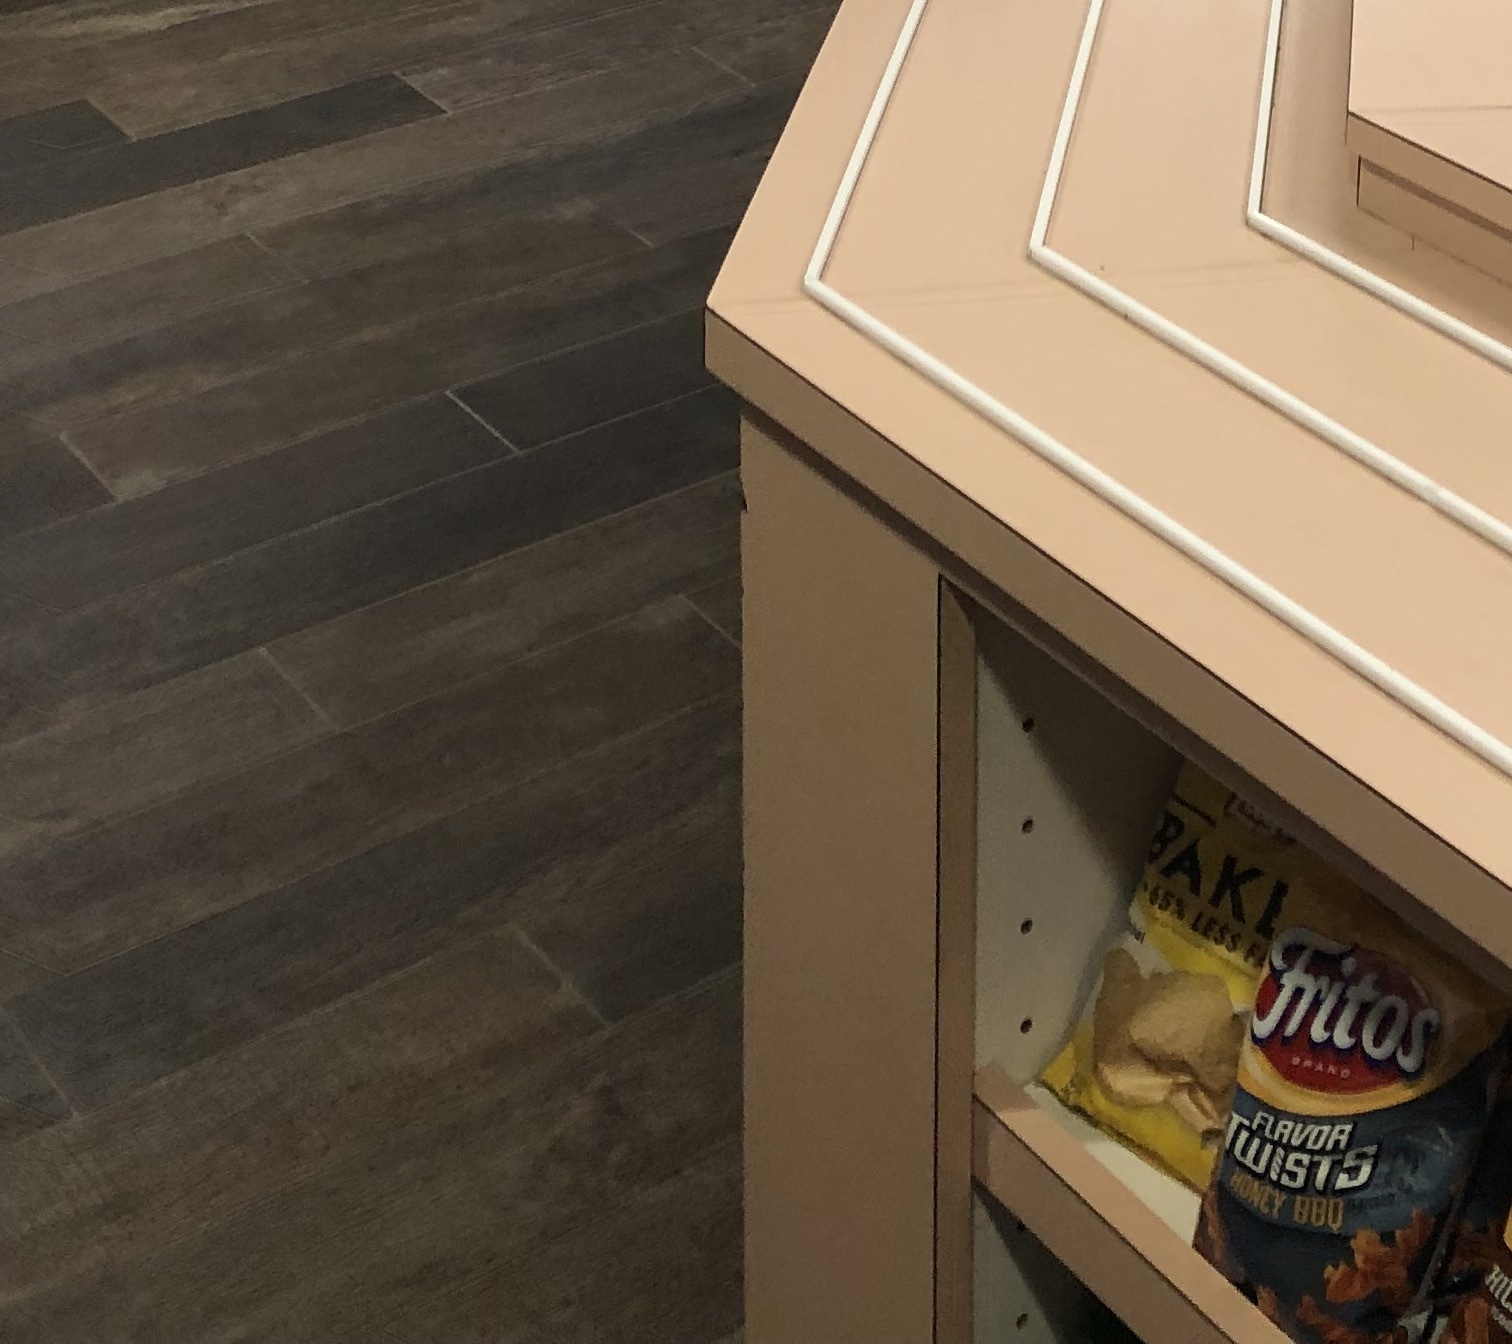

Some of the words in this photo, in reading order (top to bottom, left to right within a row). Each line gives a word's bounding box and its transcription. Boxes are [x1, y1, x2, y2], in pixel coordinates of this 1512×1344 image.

[1253, 927, 1441, 1074] Fritos
[1291, 1056, 1352, 1081] BRAND
[1225, 1111, 1380, 1194] TWISTS
[1251, 1111, 1355, 1152] FLAVOR
[1230, 1169, 1287, 1220] HONEY
[1293, 1194, 1345, 1234] BBQ
